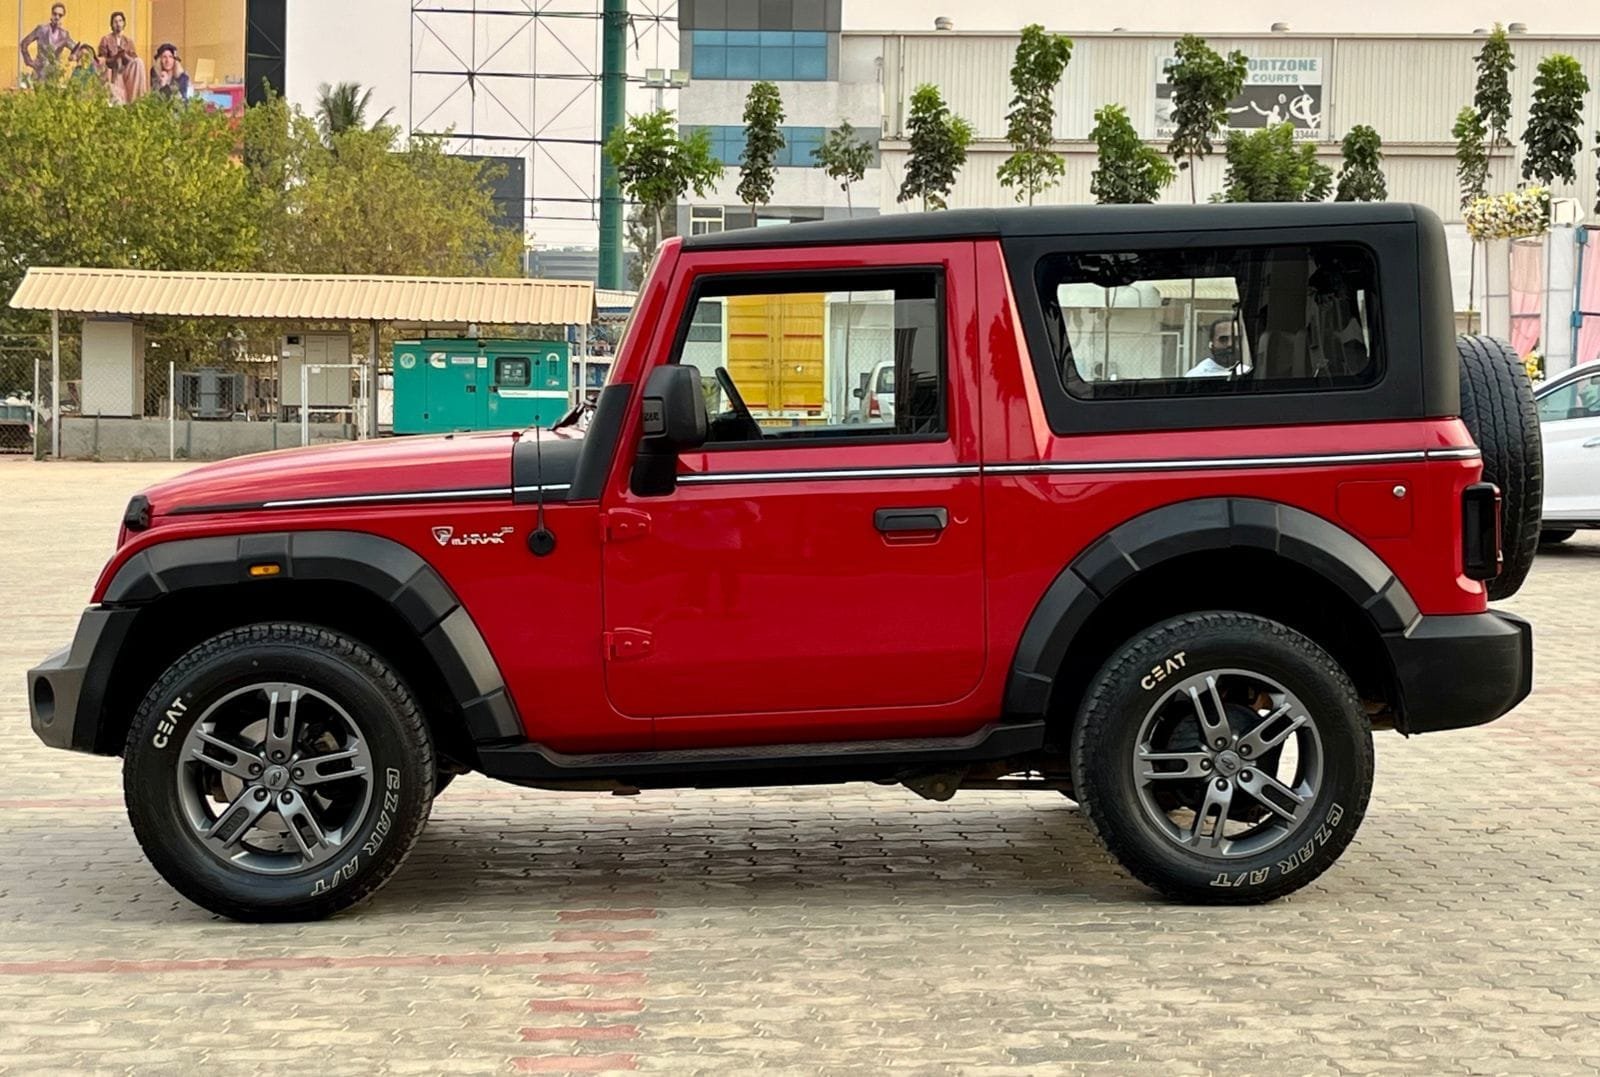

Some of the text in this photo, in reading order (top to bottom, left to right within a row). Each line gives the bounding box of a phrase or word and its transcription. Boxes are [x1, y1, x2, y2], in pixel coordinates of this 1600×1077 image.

[1247, 59, 1317, 72] ORTZONE
[1252, 73, 1299, 83] COURTS
[1294, 128, 1319, 139] 33444
[1140, 651, 1187, 691] CEAT
[152, 696, 188, 749] CEAT
[310, 767, 400, 896] CZAR A/T
[1209, 802, 1344, 887] CZAR A/T
